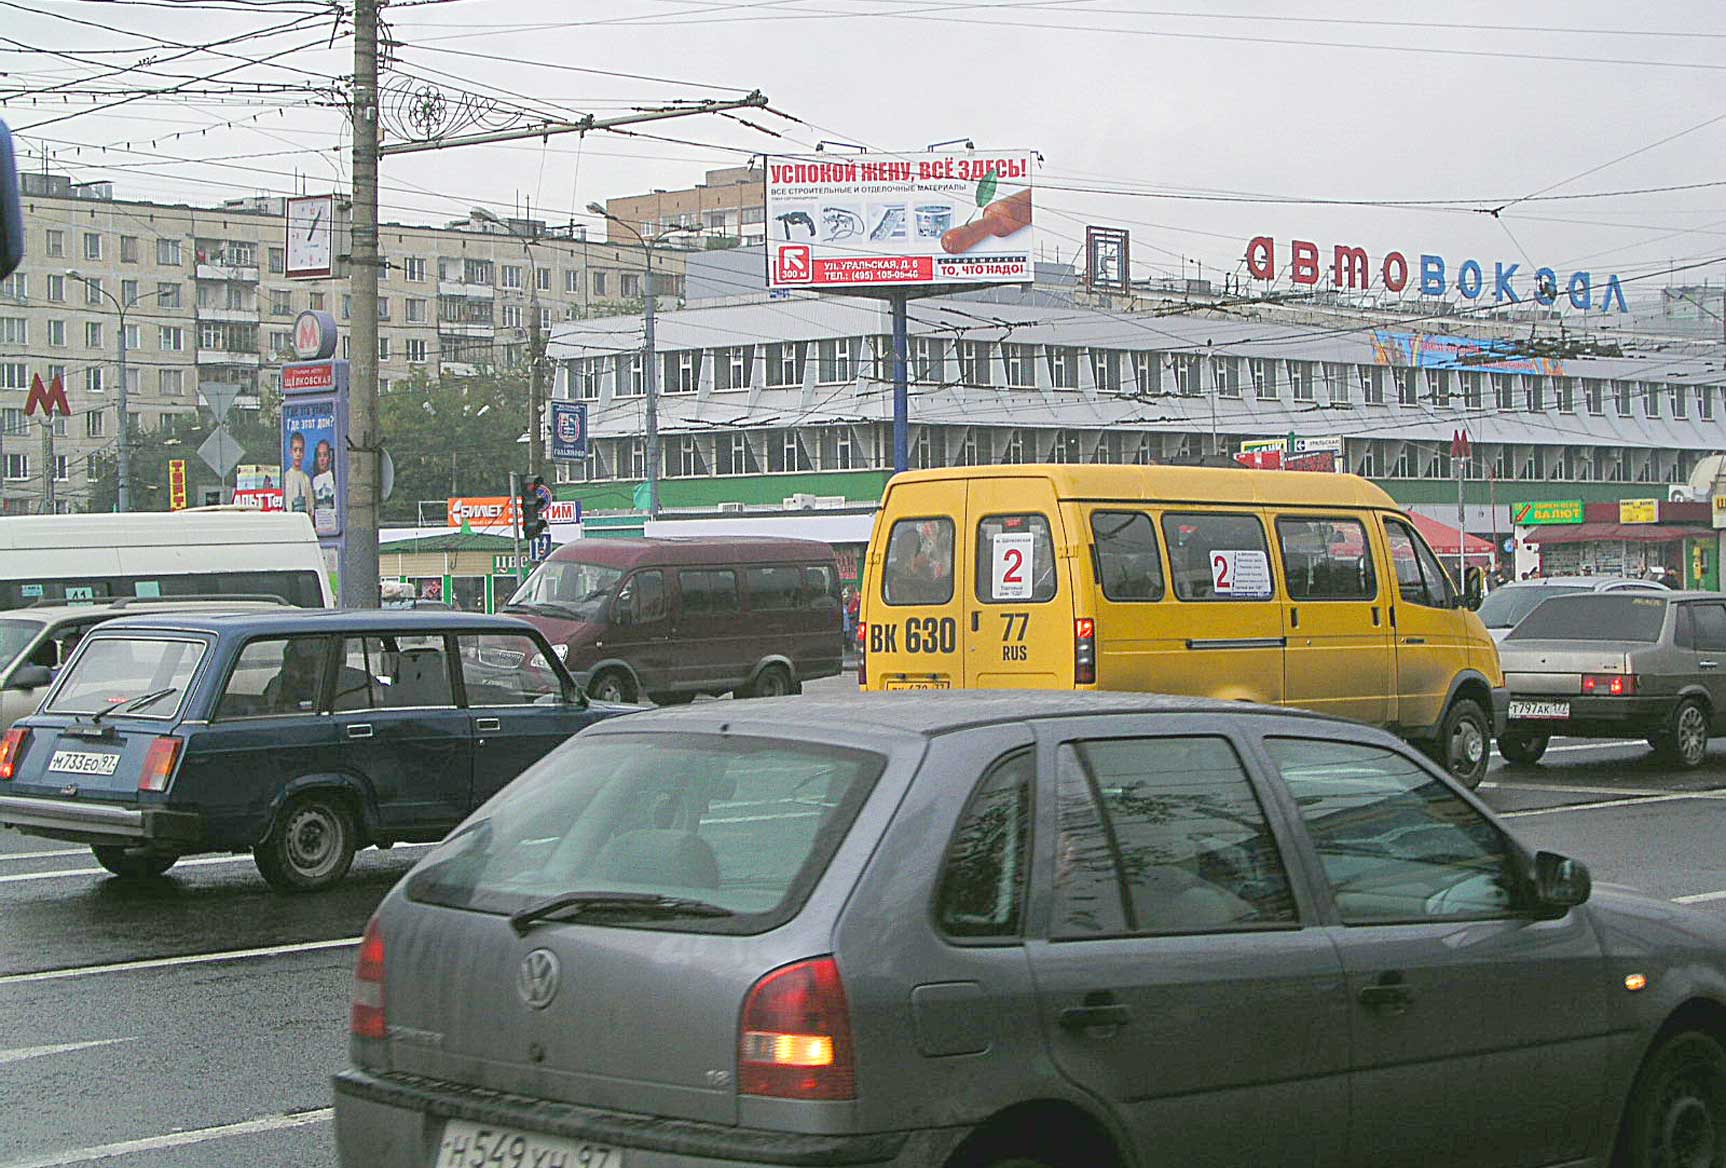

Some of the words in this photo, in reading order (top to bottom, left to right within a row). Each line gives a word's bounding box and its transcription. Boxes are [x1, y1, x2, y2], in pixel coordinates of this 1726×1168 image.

[770, 160, 856, 183] УСПОКОЙ
[862, 161, 914, 182] ЖЕНУ,
[919, 157, 953, 180] ВСЁ
[958, 159, 1026, 181] ЗДЕСЬ!
[771, 187, 786, 195] ВСЕ
[788, 186, 852, 195] СТРОИТЕЛЬНЫЕ
[861, 184, 915, 193] ОТДЕЛОЧНЫЕ
[917, 183, 966, 191] МАТЕРИАЛЫ
[782, 270, 797, 278] 300
[824, 262, 838, 270] УЛ.
[941, 266, 959, 276] ТО,
[962, 265, 983, 274] ЧТО
[987, 264, 1024, 275] НАДО!
[824, 271, 848, 280] ТЕЛ.:
[851, 271, 873, 280] (495)
[1003, 548, 1022, 583] 2
[1214, 555, 1230, 588] 2
[905, 617, 956, 653] 630
[1000, 613, 1029, 641] 77
[1003, 646, 1027, 661] RUS
[53, 754, 98, 771] М733ЕО
[102, 755, 114, 767] 97
